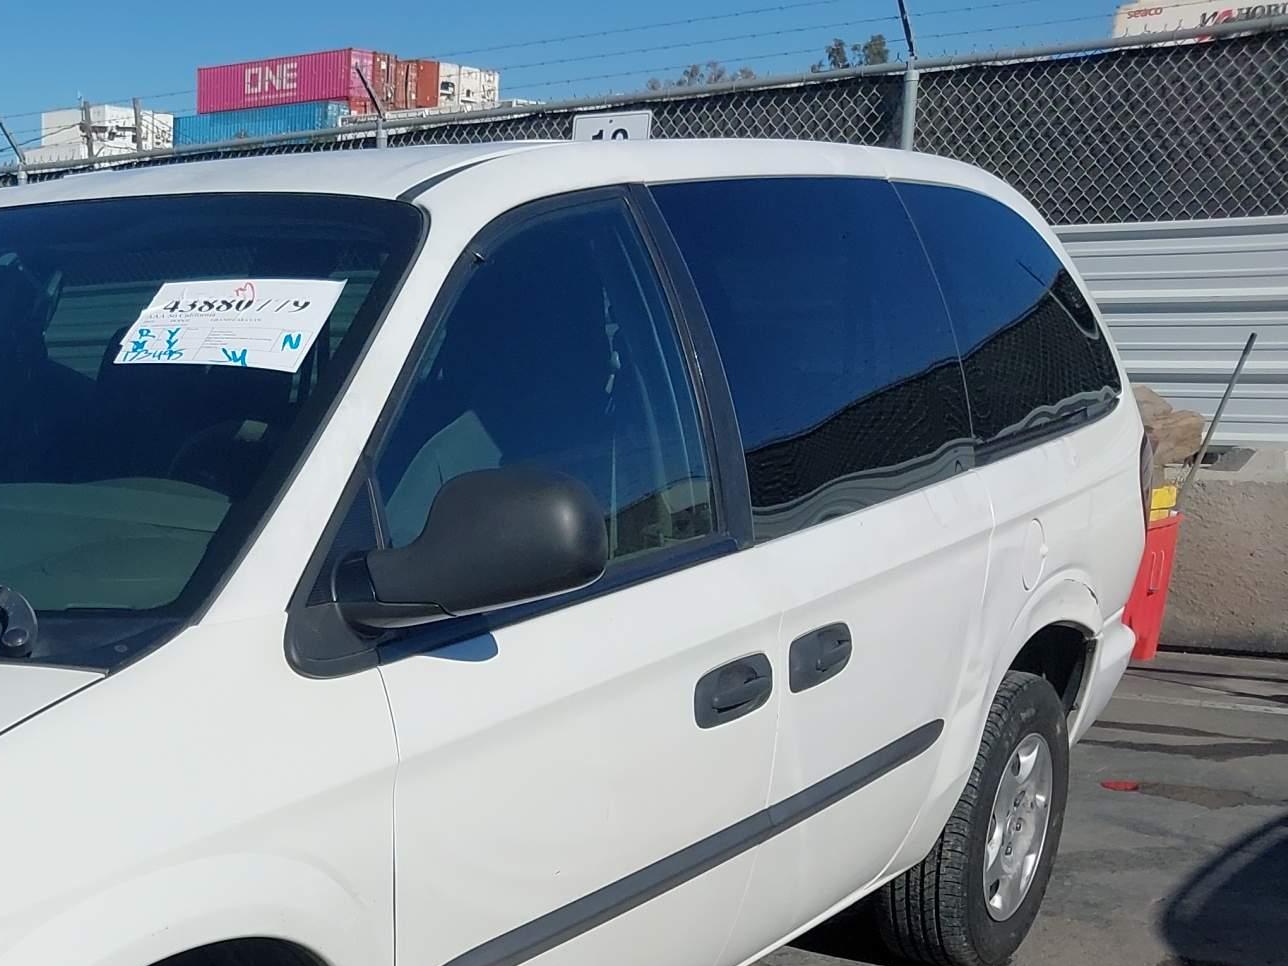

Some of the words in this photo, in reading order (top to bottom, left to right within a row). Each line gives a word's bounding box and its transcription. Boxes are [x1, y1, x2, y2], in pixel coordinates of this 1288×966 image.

[1127, 7, 1163, 19] seaco
[244, 62, 297, 95] ONE
[167, 327, 181, 339] Y
[280, 333, 302, 351] N
